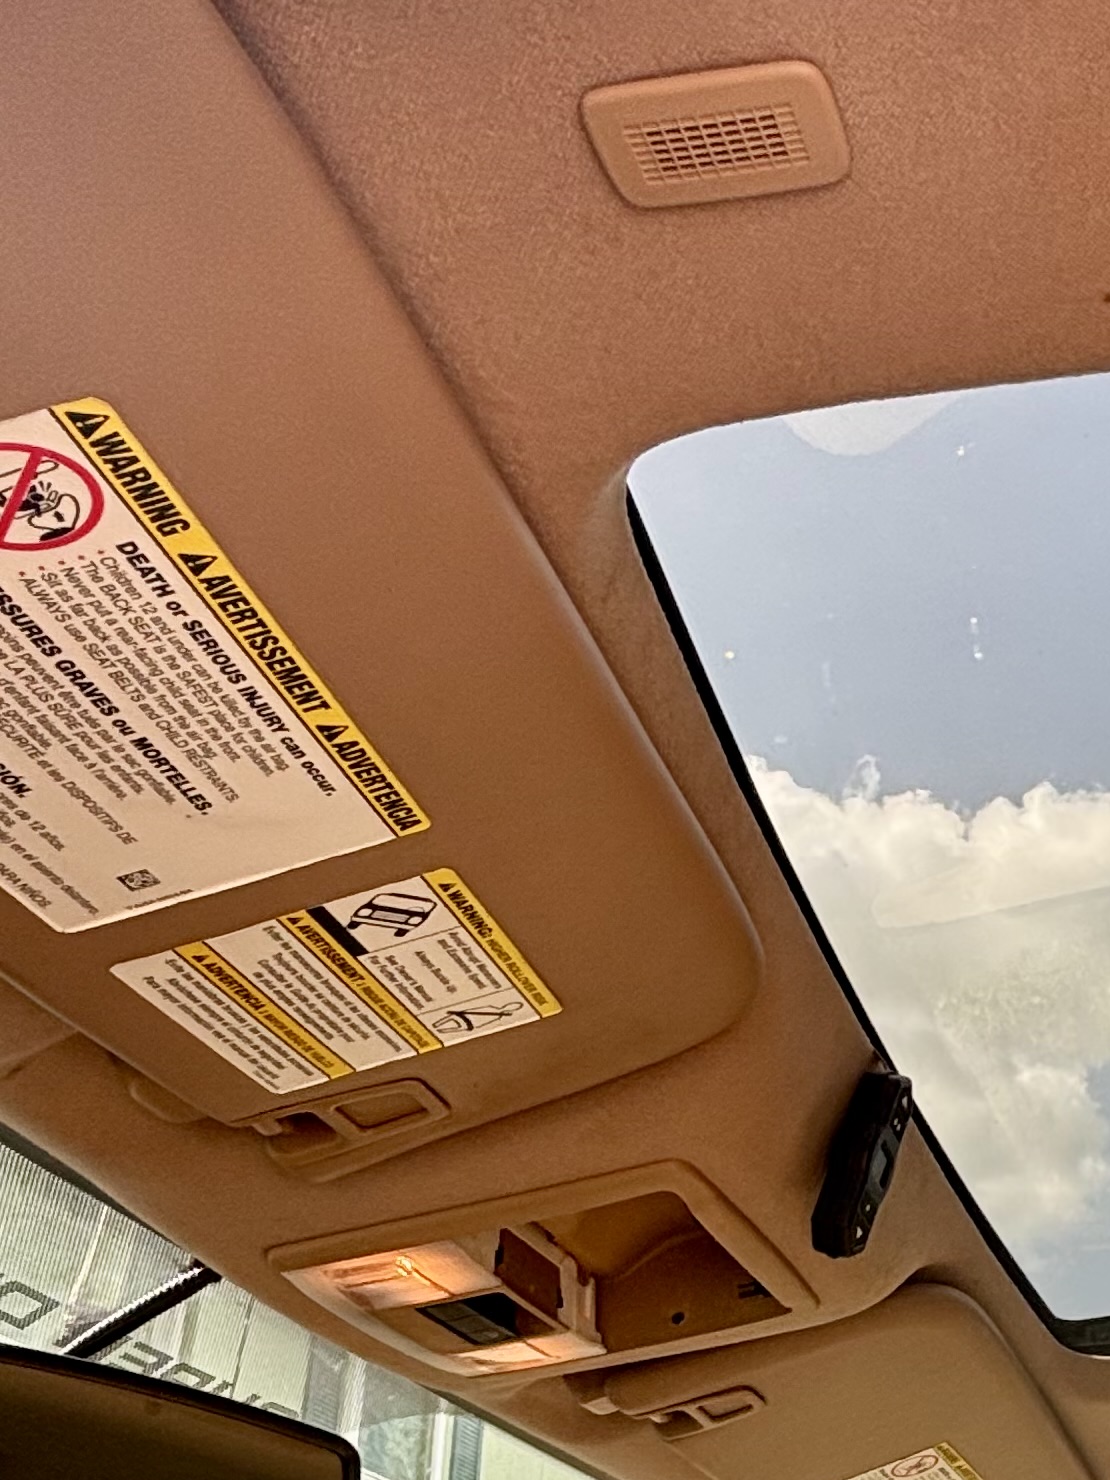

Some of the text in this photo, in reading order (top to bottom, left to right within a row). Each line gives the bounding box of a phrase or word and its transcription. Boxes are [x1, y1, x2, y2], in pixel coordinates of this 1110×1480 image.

[0, 586, 63, 657] SSURES
[54, 659, 120, 717] GRAVES
[111, 719, 136, 736] ou
[3, 659, 26, 676] LA
[18, 674, 55, 703] PLUS
[18, 578, 72, 623] ALWAYS
[63, 623, 87, 643] use
[82, 642, 118, 669] SEAT
[107, 670, 146, 703] BELTS
[137, 703, 164, 721] and
[155, 719, 190, 749] CHILD
[40, 572, 63, 589] Sit
[54, 588, 74, 603] as
[67, 602, 90, 618] far
[82, 617, 112, 643] back
[105, 643, 123, 657] as
[152, 693, 178, 716] from
[59, 566, 96, 598] Never
[85, 599, 113, 618] put
[158, 677, 187, 699] child
[80, 560, 105, 584] The
[98, 583, 137, 616] BACK
[127, 615, 163, 643] SEAT
[152, 644, 167, 655] is
[161, 654, 181, 671] the
[175, 670, 219, 708] SAFEST
[86, 431, 423, 832] WARNING AVERTISSEMENT ADVERTENCIA
[99, 556, 143, 600] Children
[138, 601, 158, 615] 12
[149, 615, 177, 636] and
[166, 635, 198, 663] under
[191, 663, 213, 681] can
[206, 680, 224, 695] be
[115, 541, 176, 598] DEATH
[165, 600, 190, 617] or
[181, 619, 247, 685] SERIOUS
[236, 685, 290, 733] INJURY
[280, 736, 306, 760] can
[28, 820, 47, 832] 12
[115, 831, 138, 845] DE
[295, 924, 366, 982] AVERTISSEMENT
[446, 889, 493, 939] WARNING:
[201, 962, 266, 1011] ADVERTENCIA
